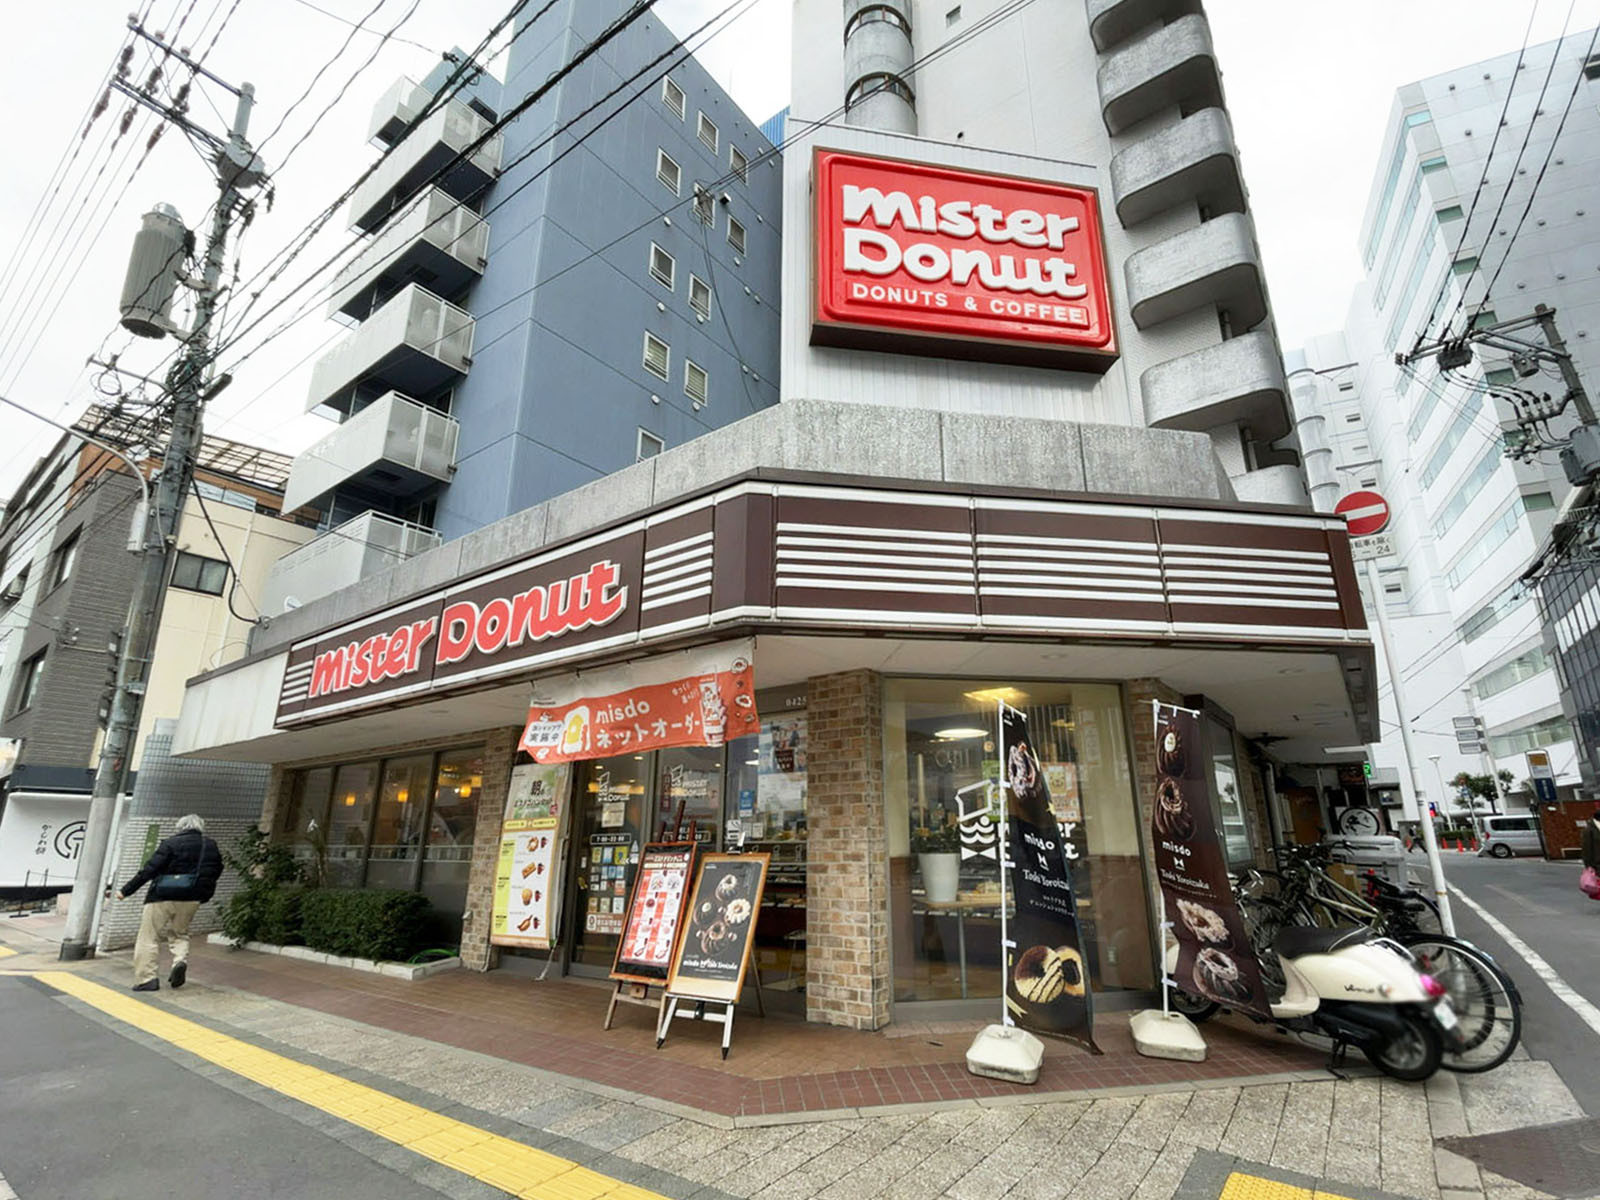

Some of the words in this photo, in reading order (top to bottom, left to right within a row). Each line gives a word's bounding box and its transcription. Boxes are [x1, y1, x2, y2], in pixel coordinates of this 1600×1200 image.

[842, 227, 1088, 299] Donut
[853, 283, 947, 307] DONUTS
[964, 297, 977, 310] &
[990, 299, 1085, 324] COFFEE
[1350, 536, 1390, 549] 転車を除く
[435, 560, 629, 665] Donut
[594, 698, 651, 725] misdo
